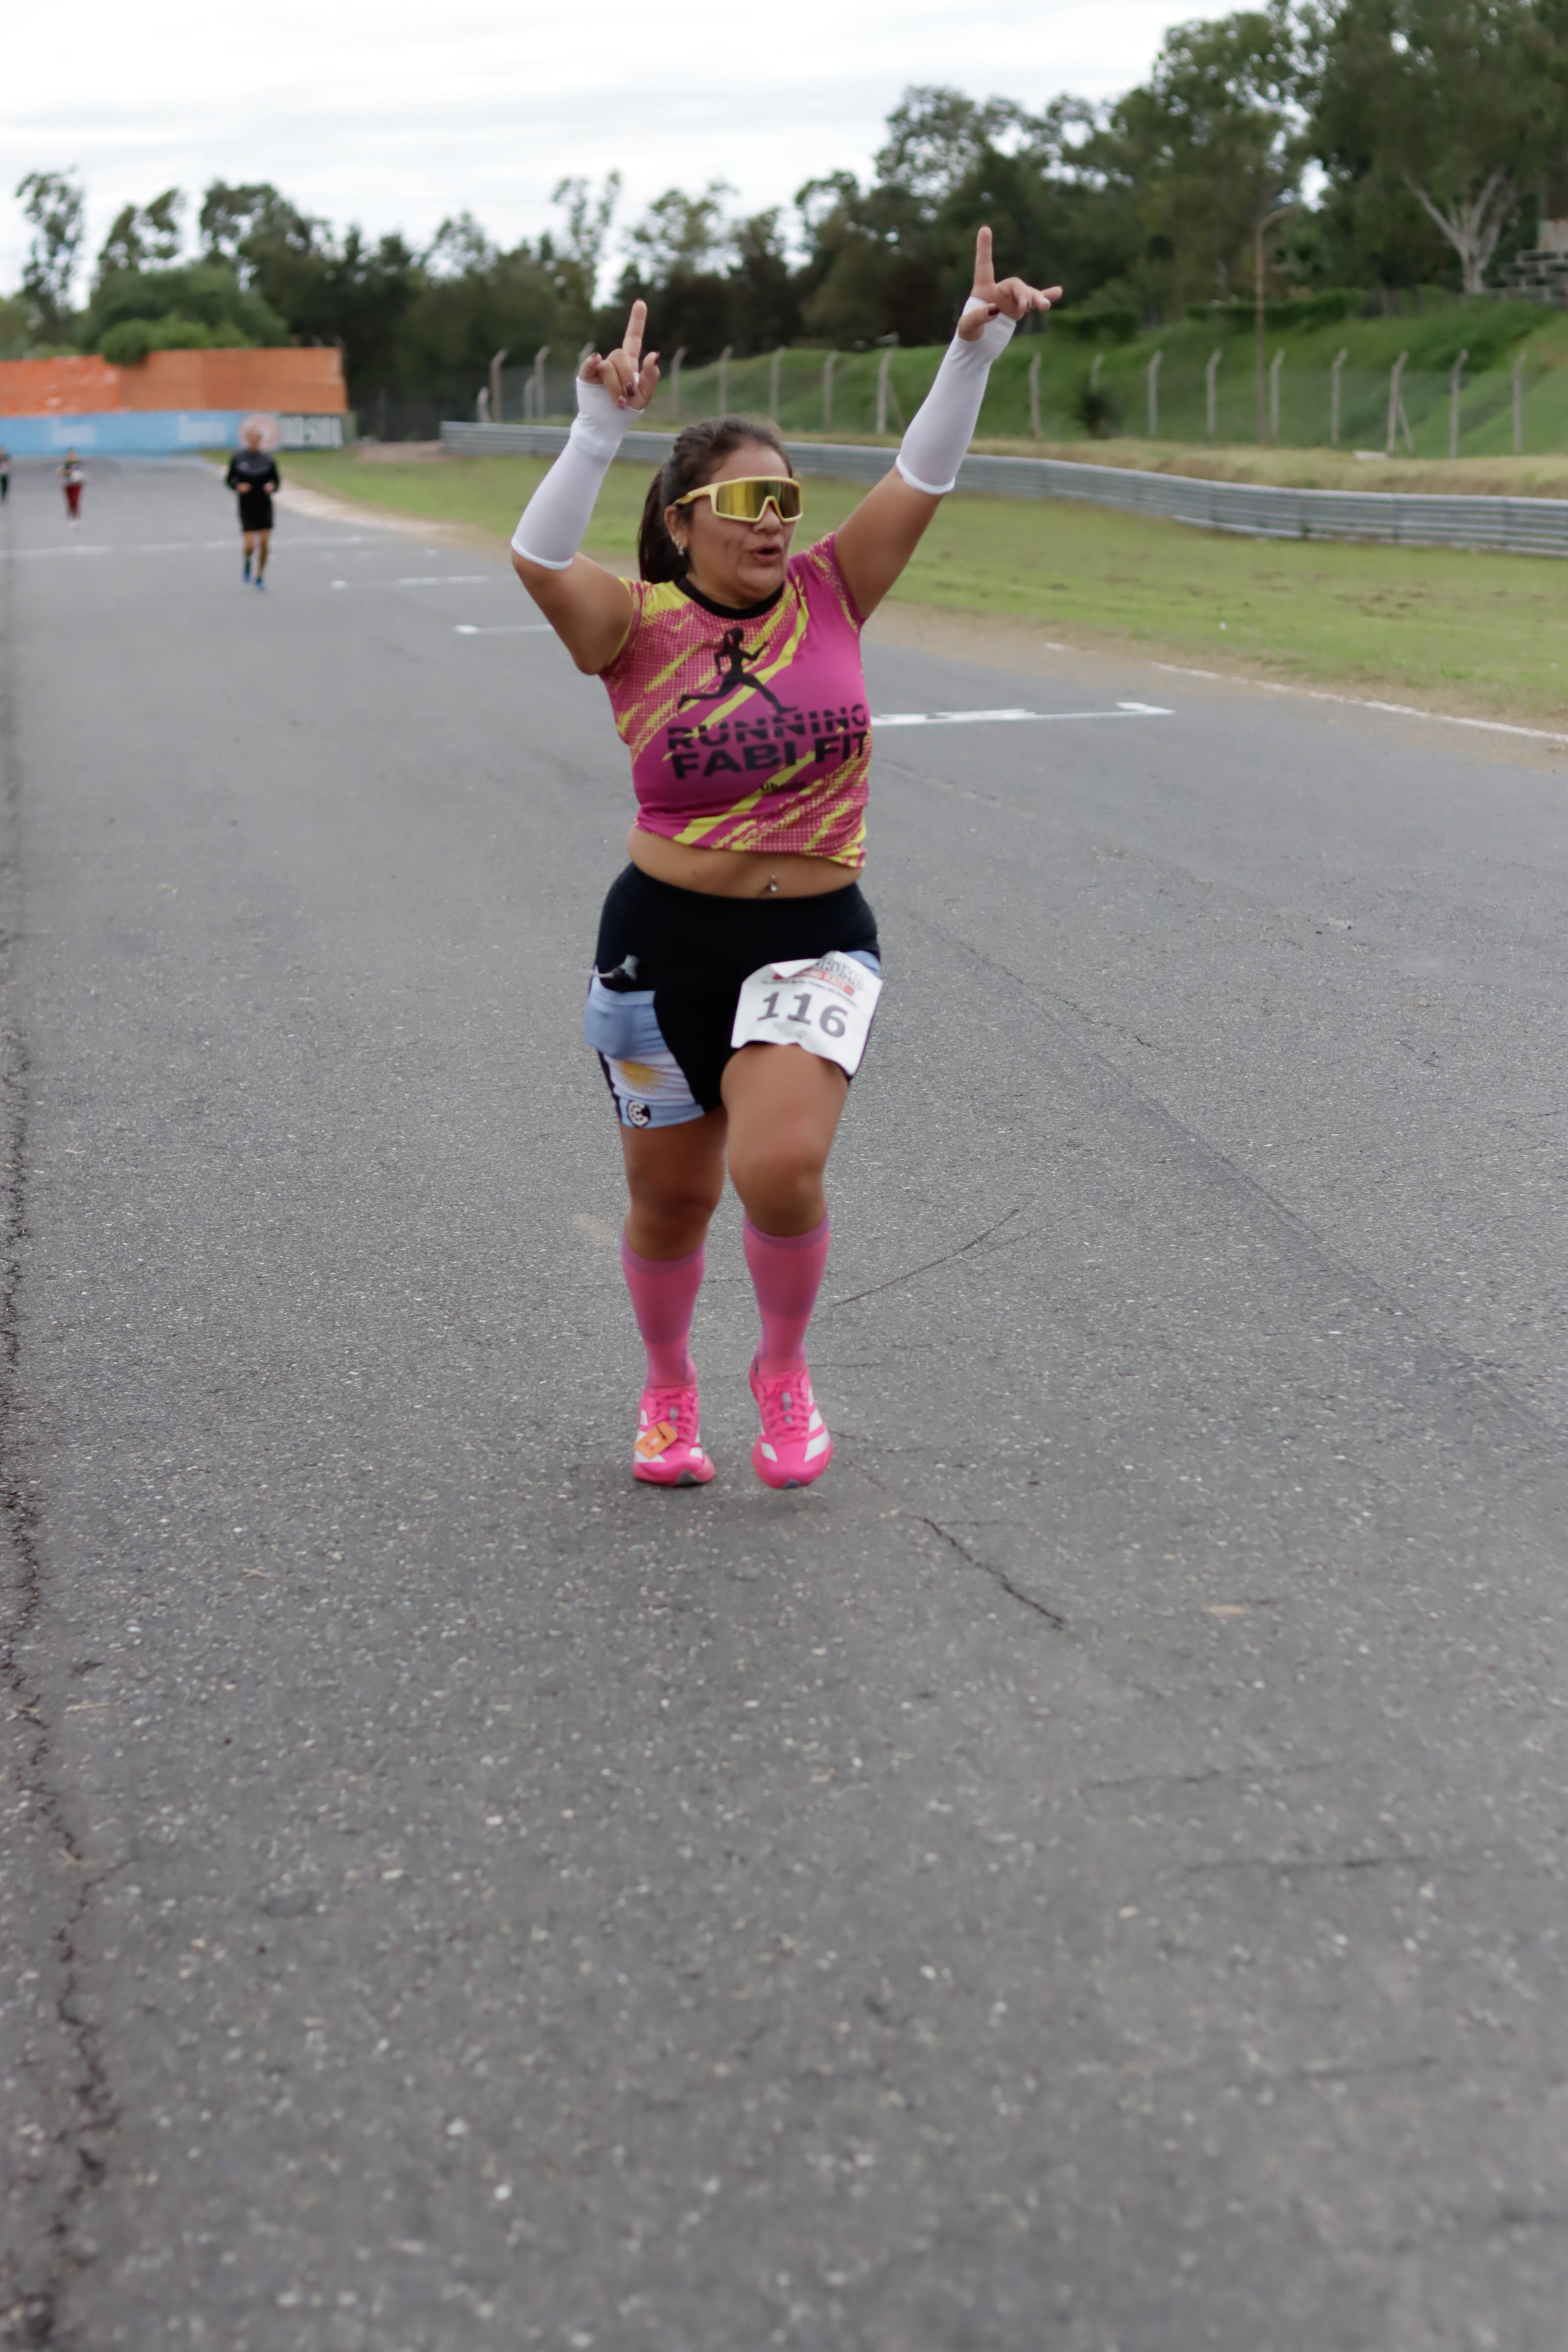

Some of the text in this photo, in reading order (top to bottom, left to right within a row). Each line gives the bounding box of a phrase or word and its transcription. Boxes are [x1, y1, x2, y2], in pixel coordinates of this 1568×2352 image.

[668, 704, 867, 749] RUNNING
[672, 731, 867, 779] FABI FIT
[756, 991, 848, 1038] 116
